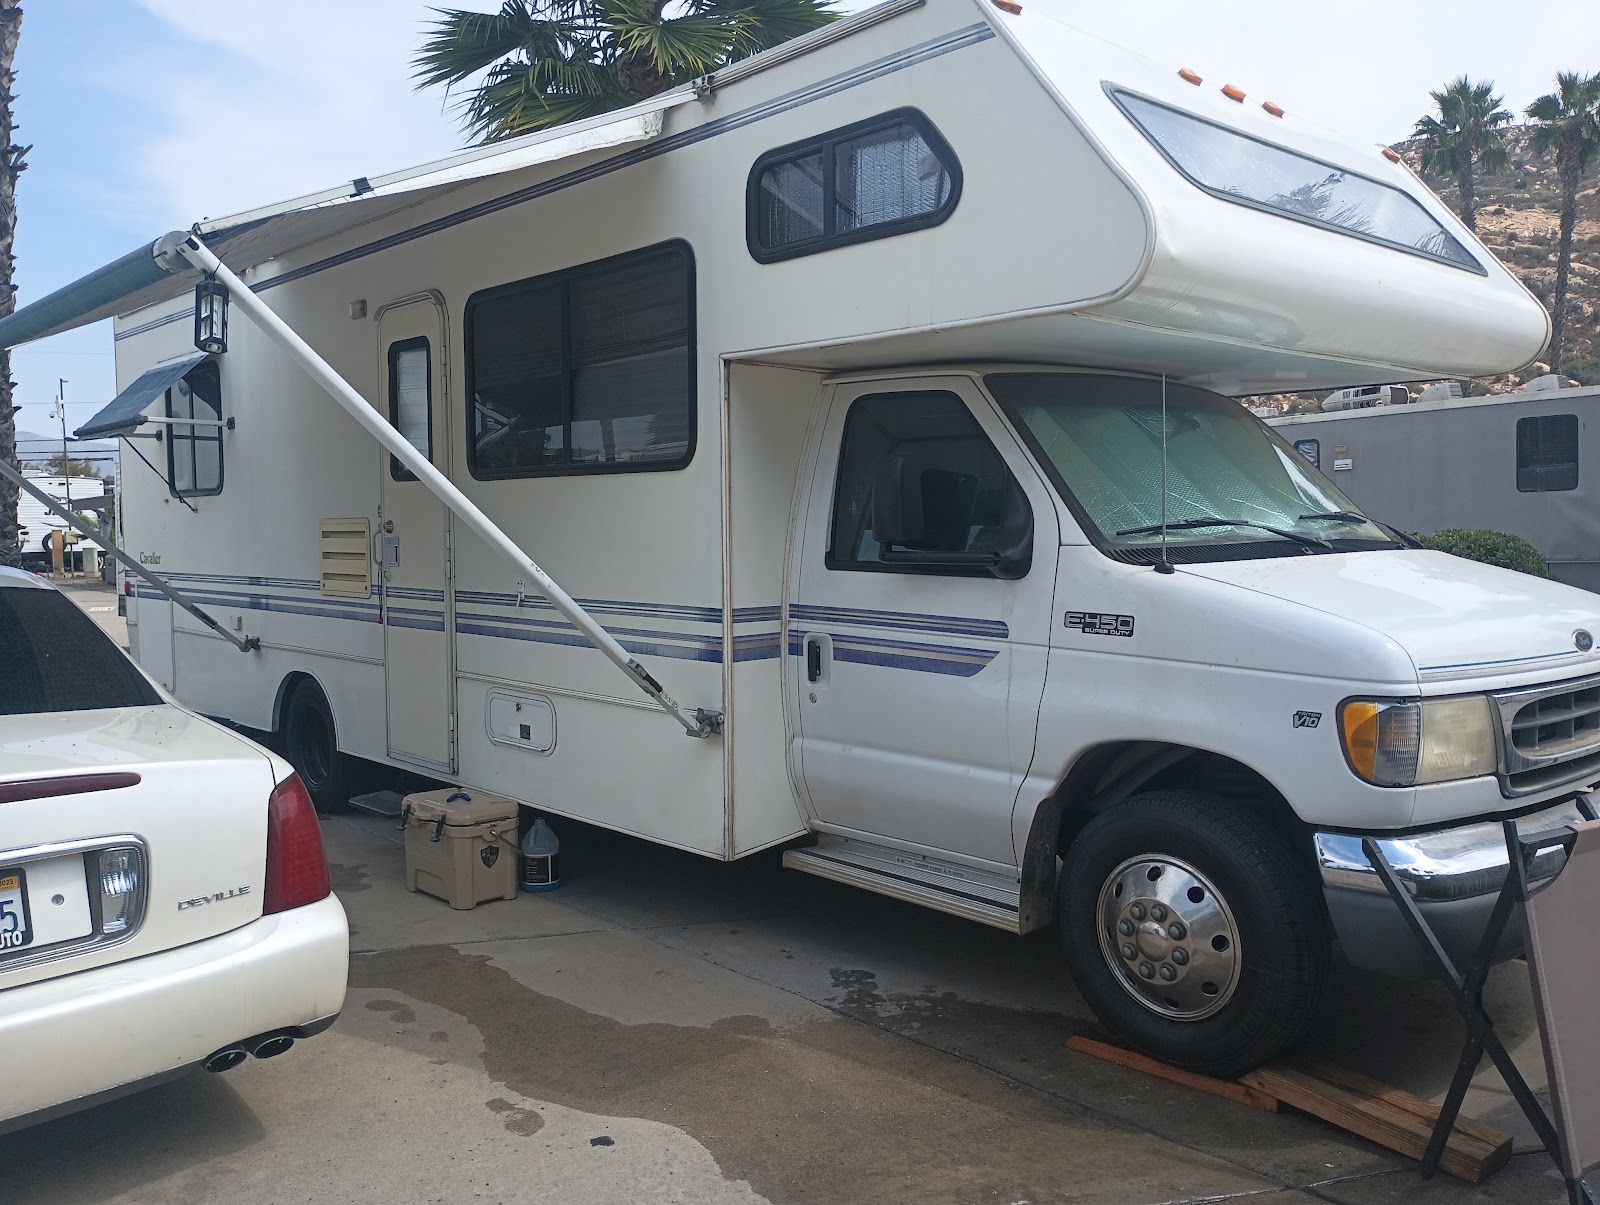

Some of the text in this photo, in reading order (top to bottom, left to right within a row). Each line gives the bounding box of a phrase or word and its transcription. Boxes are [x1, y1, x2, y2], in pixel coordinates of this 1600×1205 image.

[140, 551, 161, 565] Cavalier
[1084, 627, 1108, 635] SUPER
[1293, 714, 1319, 728] V10
[178, 884, 252, 911] DEVILLE
